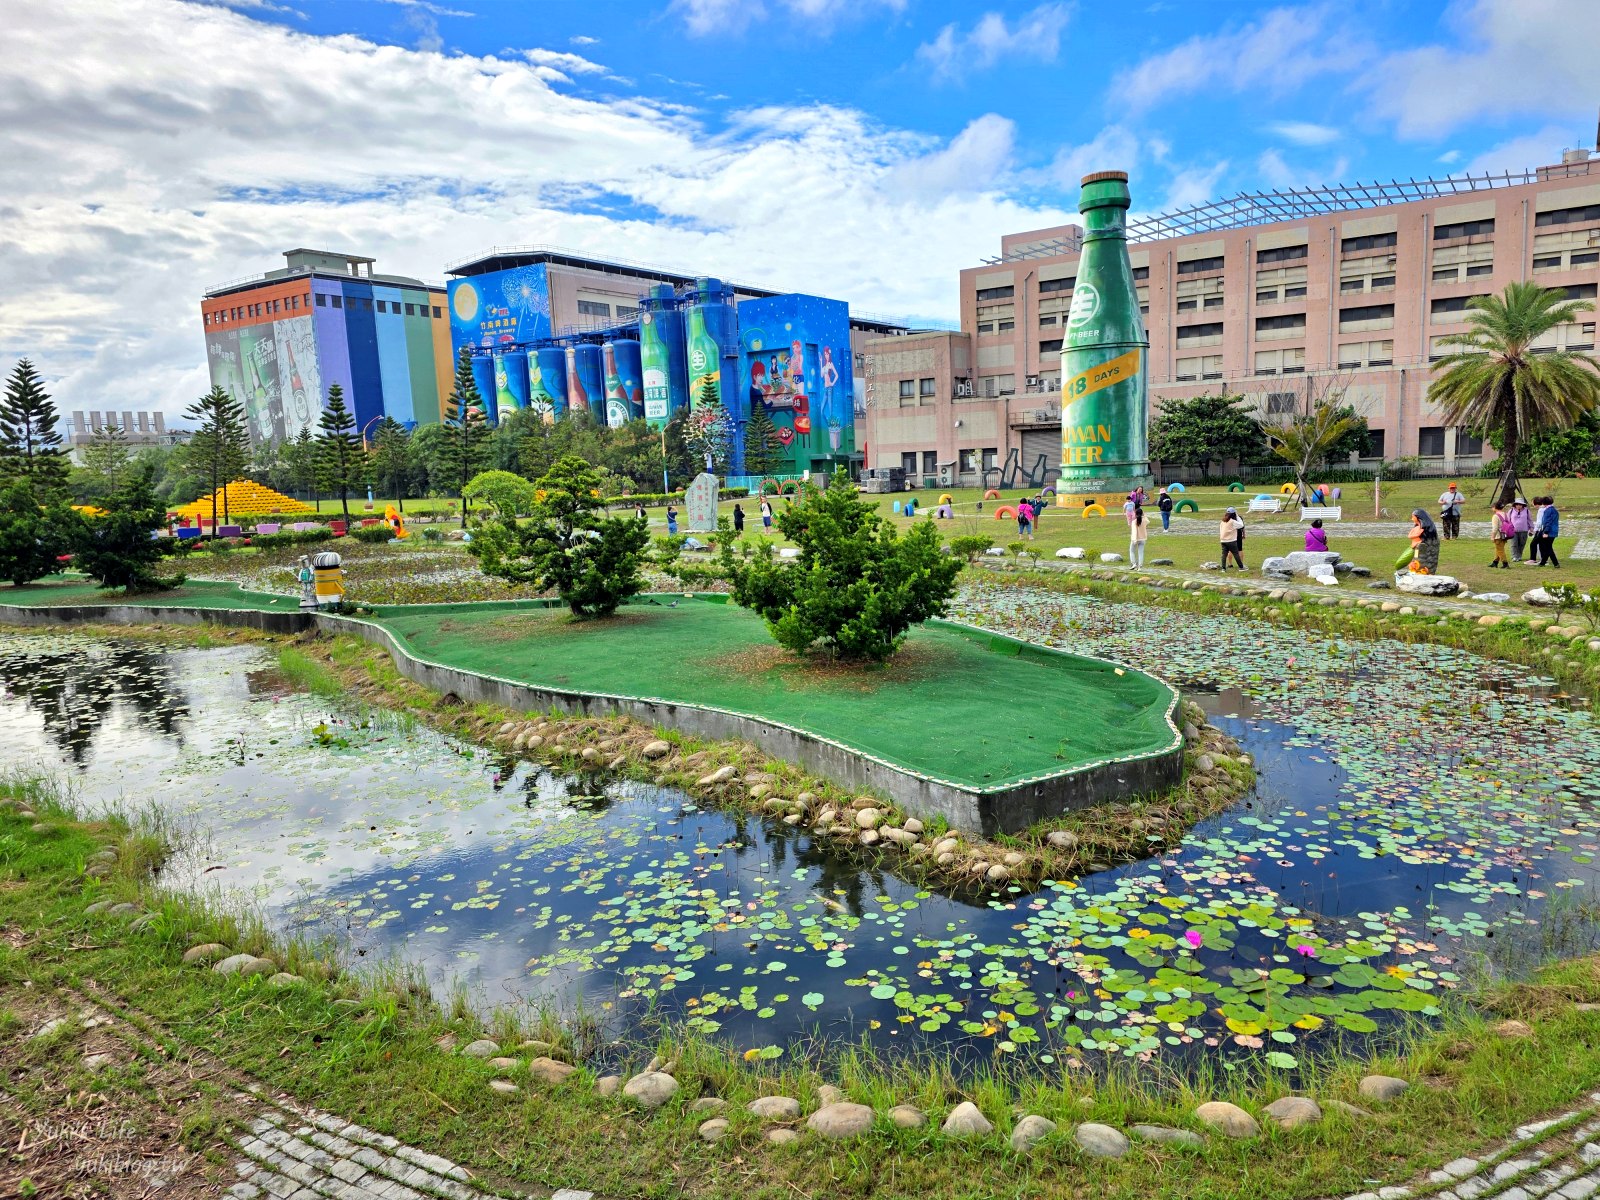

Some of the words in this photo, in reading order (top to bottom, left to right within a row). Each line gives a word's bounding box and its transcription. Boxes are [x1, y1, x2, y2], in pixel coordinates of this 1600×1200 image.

[1079, 330, 1100, 338] BEER
[1068, 376, 1087, 399] 18
[1094, 366, 1120, 383] DAYS
[1062, 446, 1103, 465] BEER
